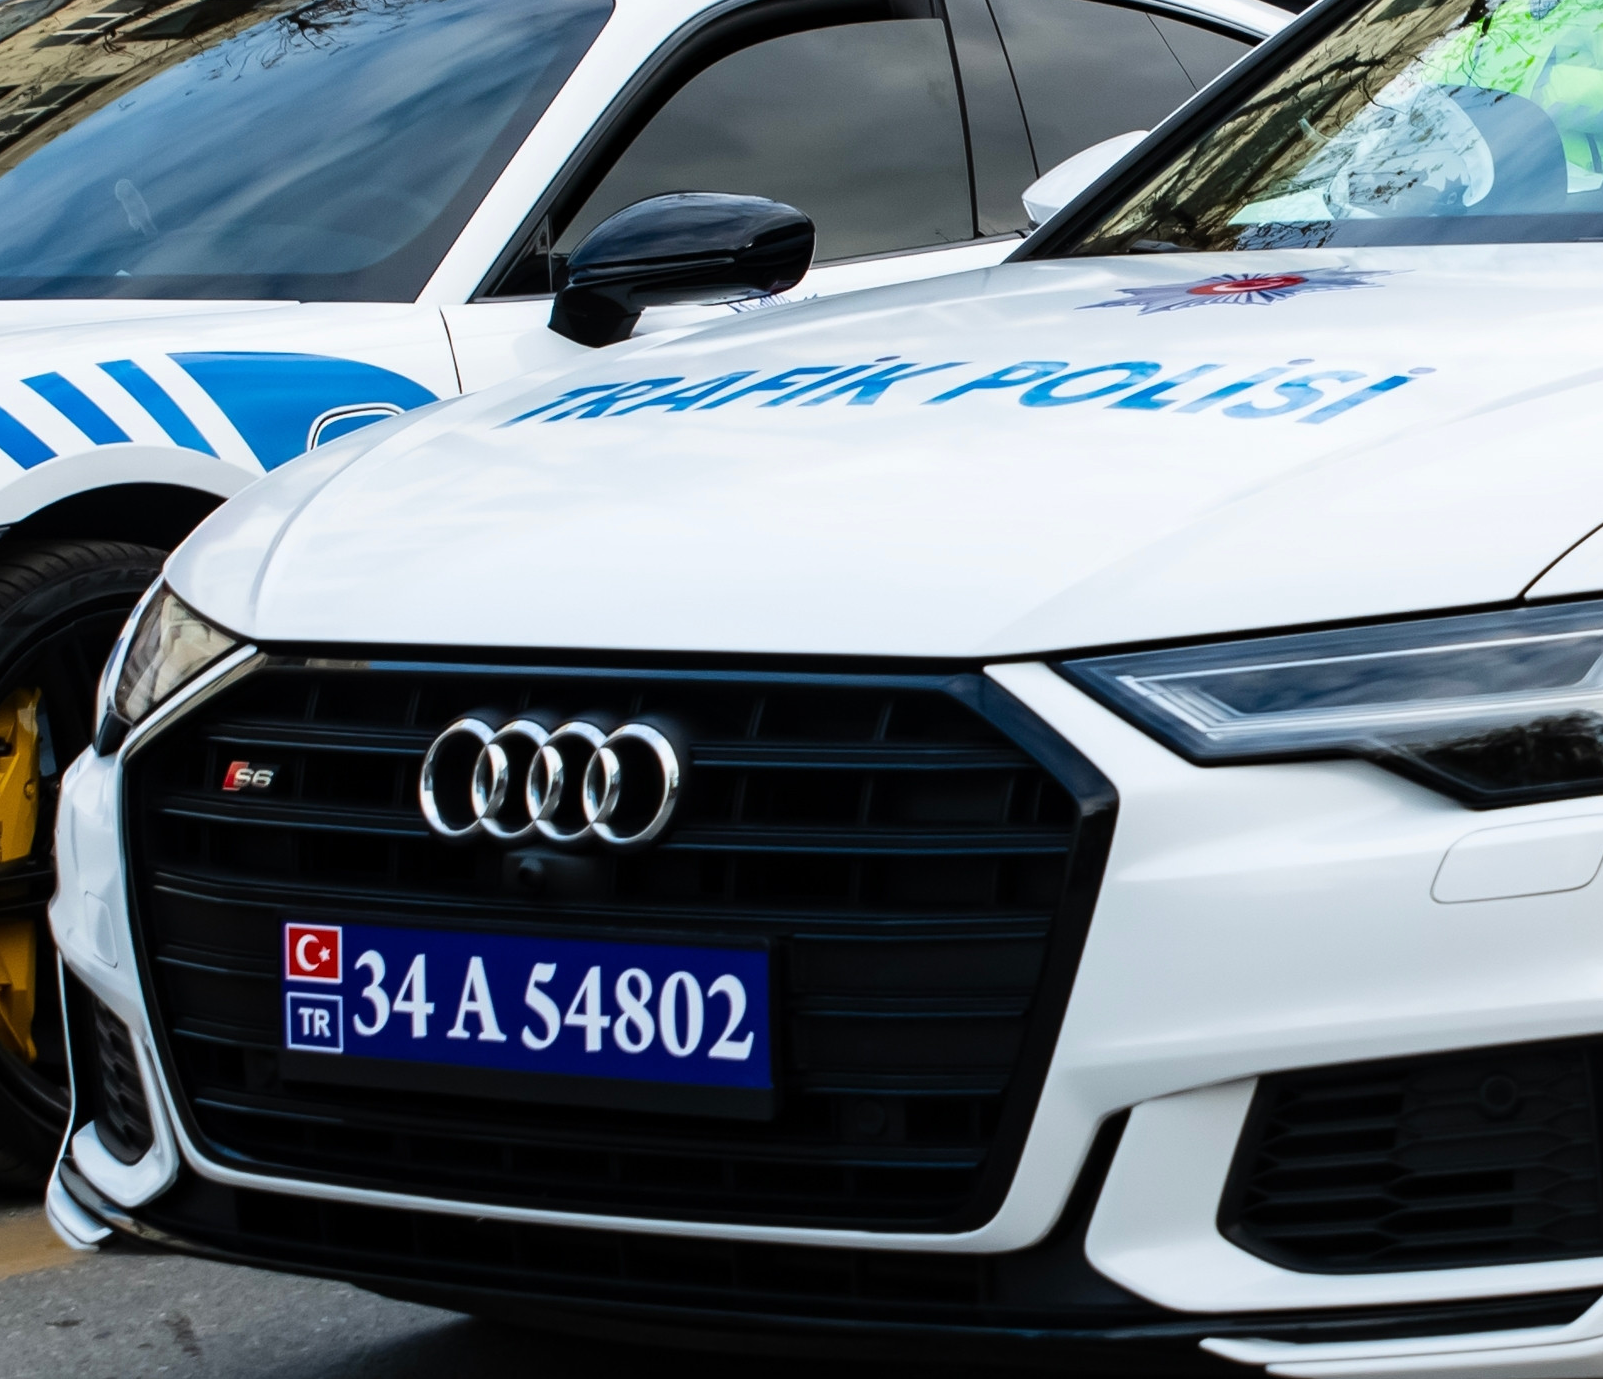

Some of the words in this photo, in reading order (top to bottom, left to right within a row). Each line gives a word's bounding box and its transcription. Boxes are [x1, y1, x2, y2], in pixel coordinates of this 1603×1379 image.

[493, 355, 973, 429] TRAFİK
[925, 356, 1438, 425] POLİSİ
[232, 764, 275, 791] S6
[296, 1005, 331, 1040] TR
[351, 947, 436, 1041] 34
[446, 954, 508, 1045] A
[520, 960, 755, 1063] 54802
